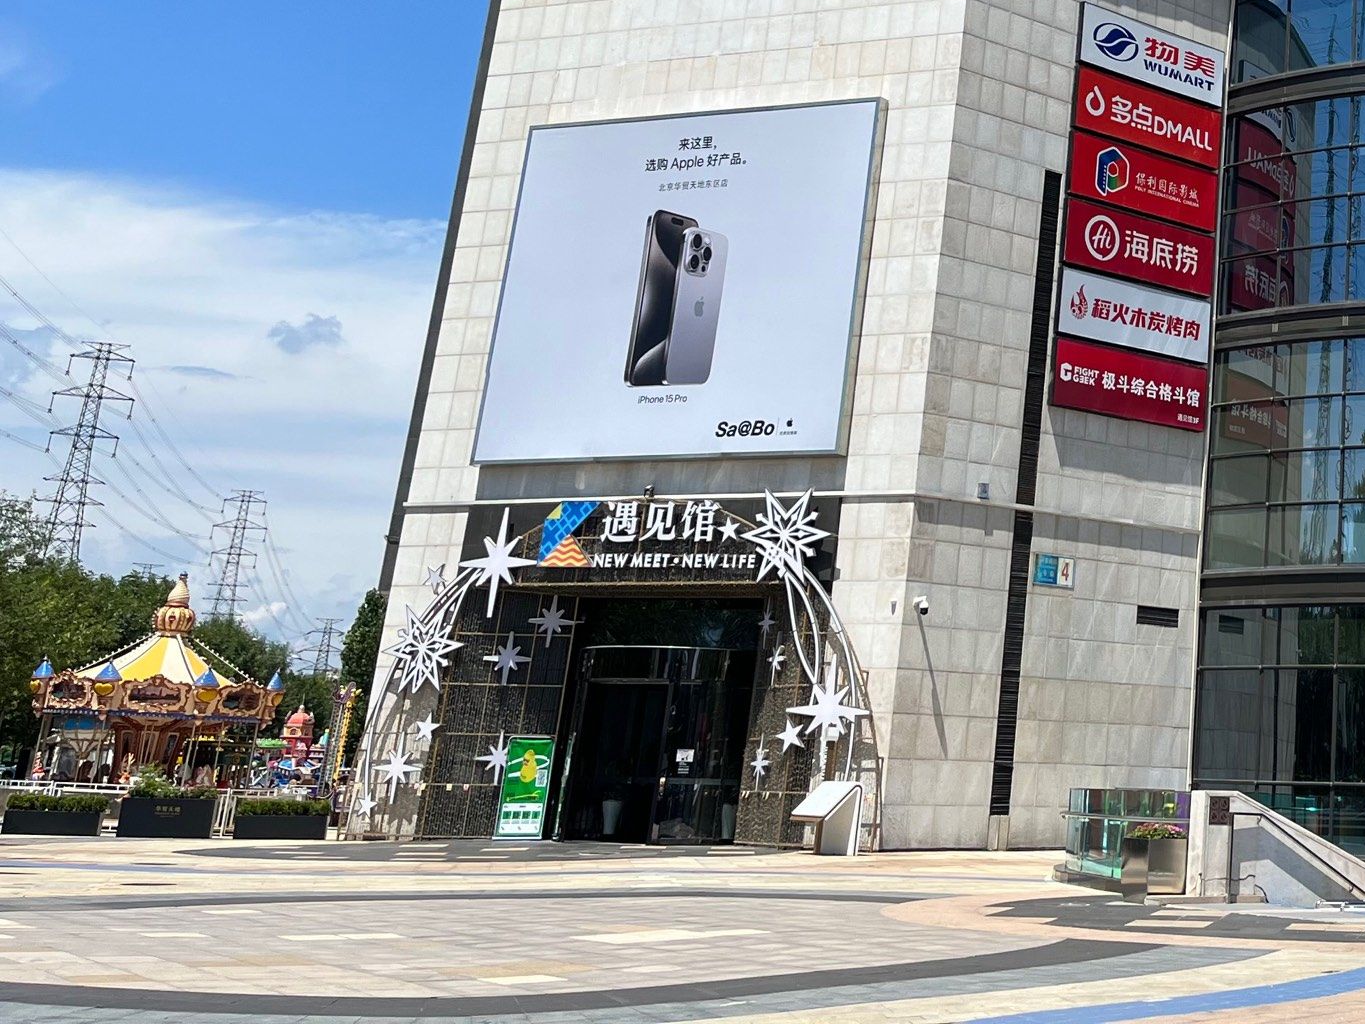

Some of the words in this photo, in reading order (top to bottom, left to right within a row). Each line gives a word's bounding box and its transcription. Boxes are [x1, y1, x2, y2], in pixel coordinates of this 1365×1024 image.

[1144, 36, 1216, 79] 物美
[1143, 59, 1215, 92] WUMART
[645, 157, 669, 172] 选购
[670, 155, 704, 171] Apple
[1135, 172, 1199, 203] 保利国际影城
[1123, 229, 1199, 276] 海底捞
[1072, 374, 1096, 387] GEEK
[1074, 365, 1100, 379] FIGHT
[637, 394, 664, 404] iPhone
[665, 394, 674, 403] 15
[674, 394, 688, 403] Pro
[1101, 372, 1200, 408] 极斗综合格斗馆
[715, 420, 775, 438] Sa@Bo
[600, 499, 722, 543] 遇见馆
[592, 553, 629, 568] NEW
[630, 553, 672, 568] MEET
[681, 553, 720, 568] NEW
[723, 554, 757, 569] LIFE
[1061, 562, 1070, 581] 4
